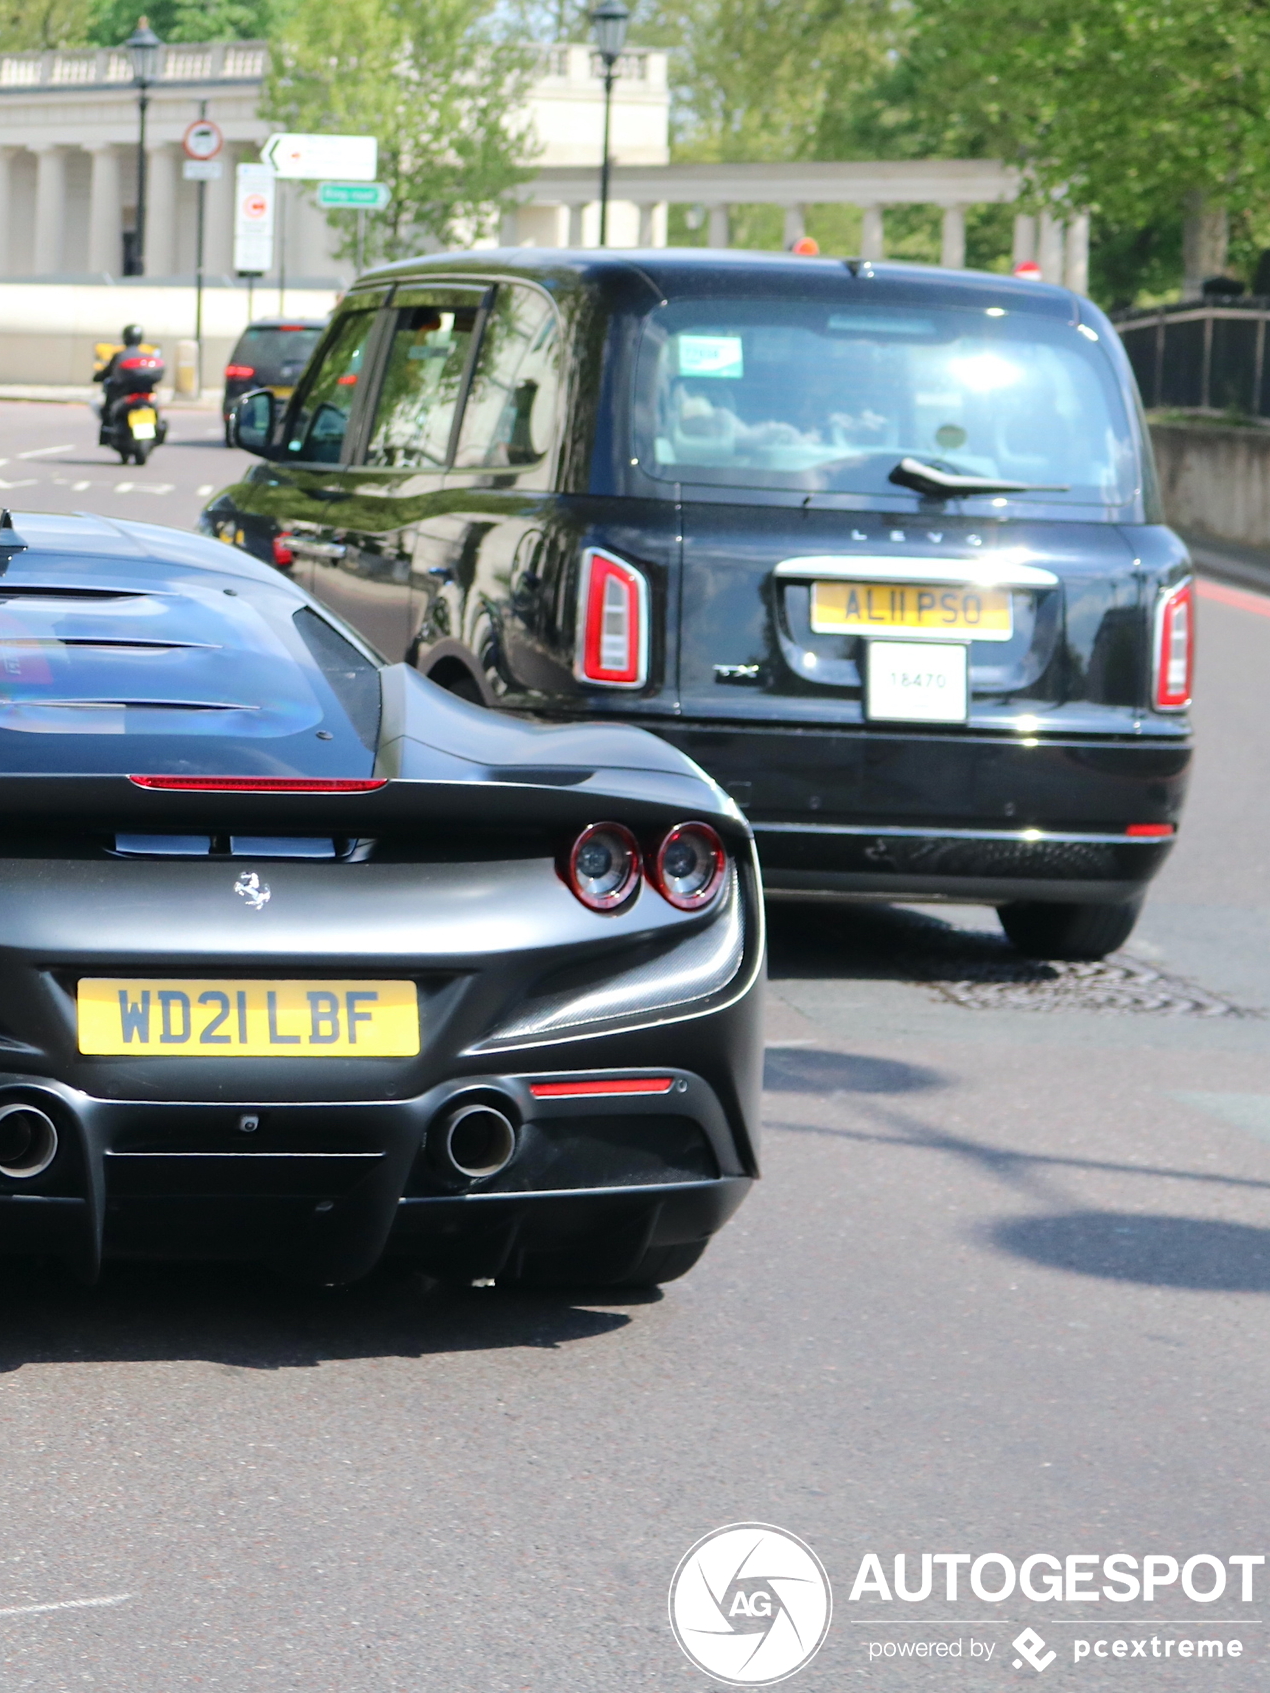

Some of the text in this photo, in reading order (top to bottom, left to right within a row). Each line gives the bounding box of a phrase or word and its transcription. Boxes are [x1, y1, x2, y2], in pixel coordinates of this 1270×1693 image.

[890, 672, 946, 688] 18470
[118, 990, 379, 1045] WD21 LBF
